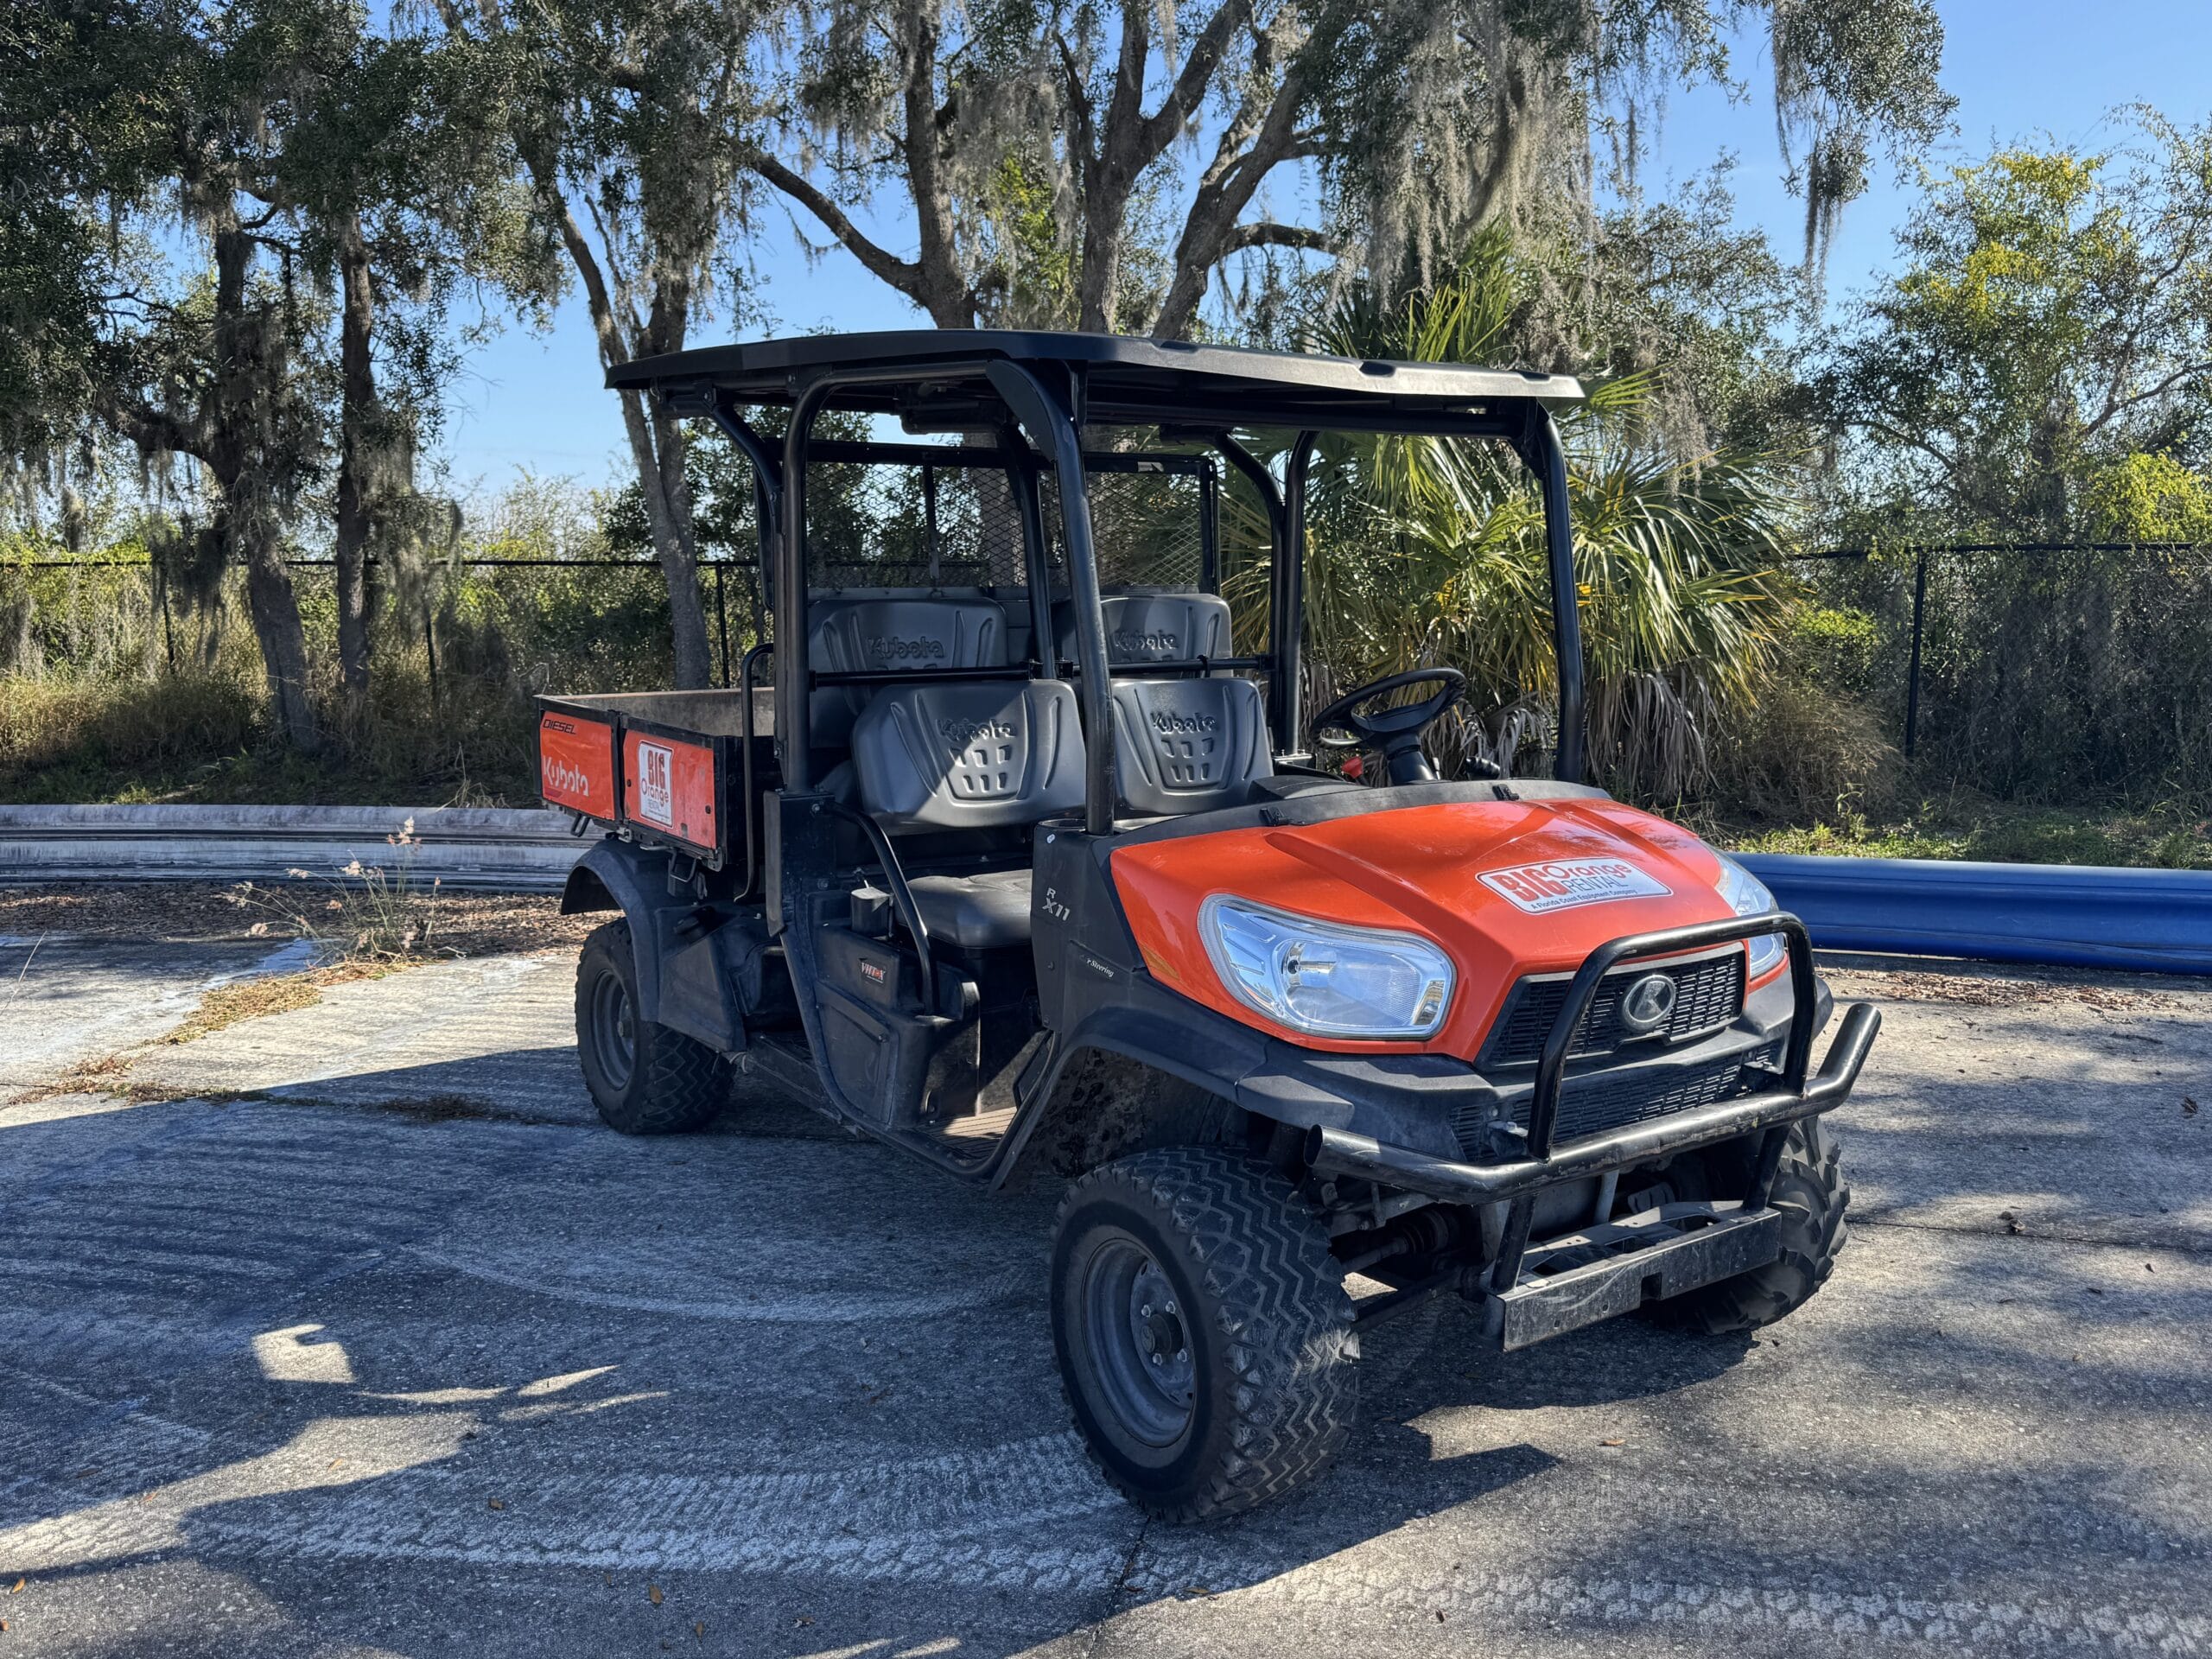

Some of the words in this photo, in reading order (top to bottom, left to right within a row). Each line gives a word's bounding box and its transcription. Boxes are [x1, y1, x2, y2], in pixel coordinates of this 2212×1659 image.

[866, 635, 945, 659] Kubota
[1114, 629, 1179, 652] Kubota
[543, 719, 577, 734] DIESEL
[936, 718, 1018, 743] Kubota
[1149, 712, 1219, 734] Kubota
[543, 754, 589, 797] Kubota
[647, 750, 665, 790] BIG
[641, 778, 670, 808] Orange
[1541, 864, 1632, 879] Orange
[1046, 887, 1056, 899] R
[1489, 868, 1569, 902] BIG
[1560, 875, 1629, 894] RENTAL
[1041, 897, 1071, 921] X11
[1090, 960, 1115, 977] Steering
